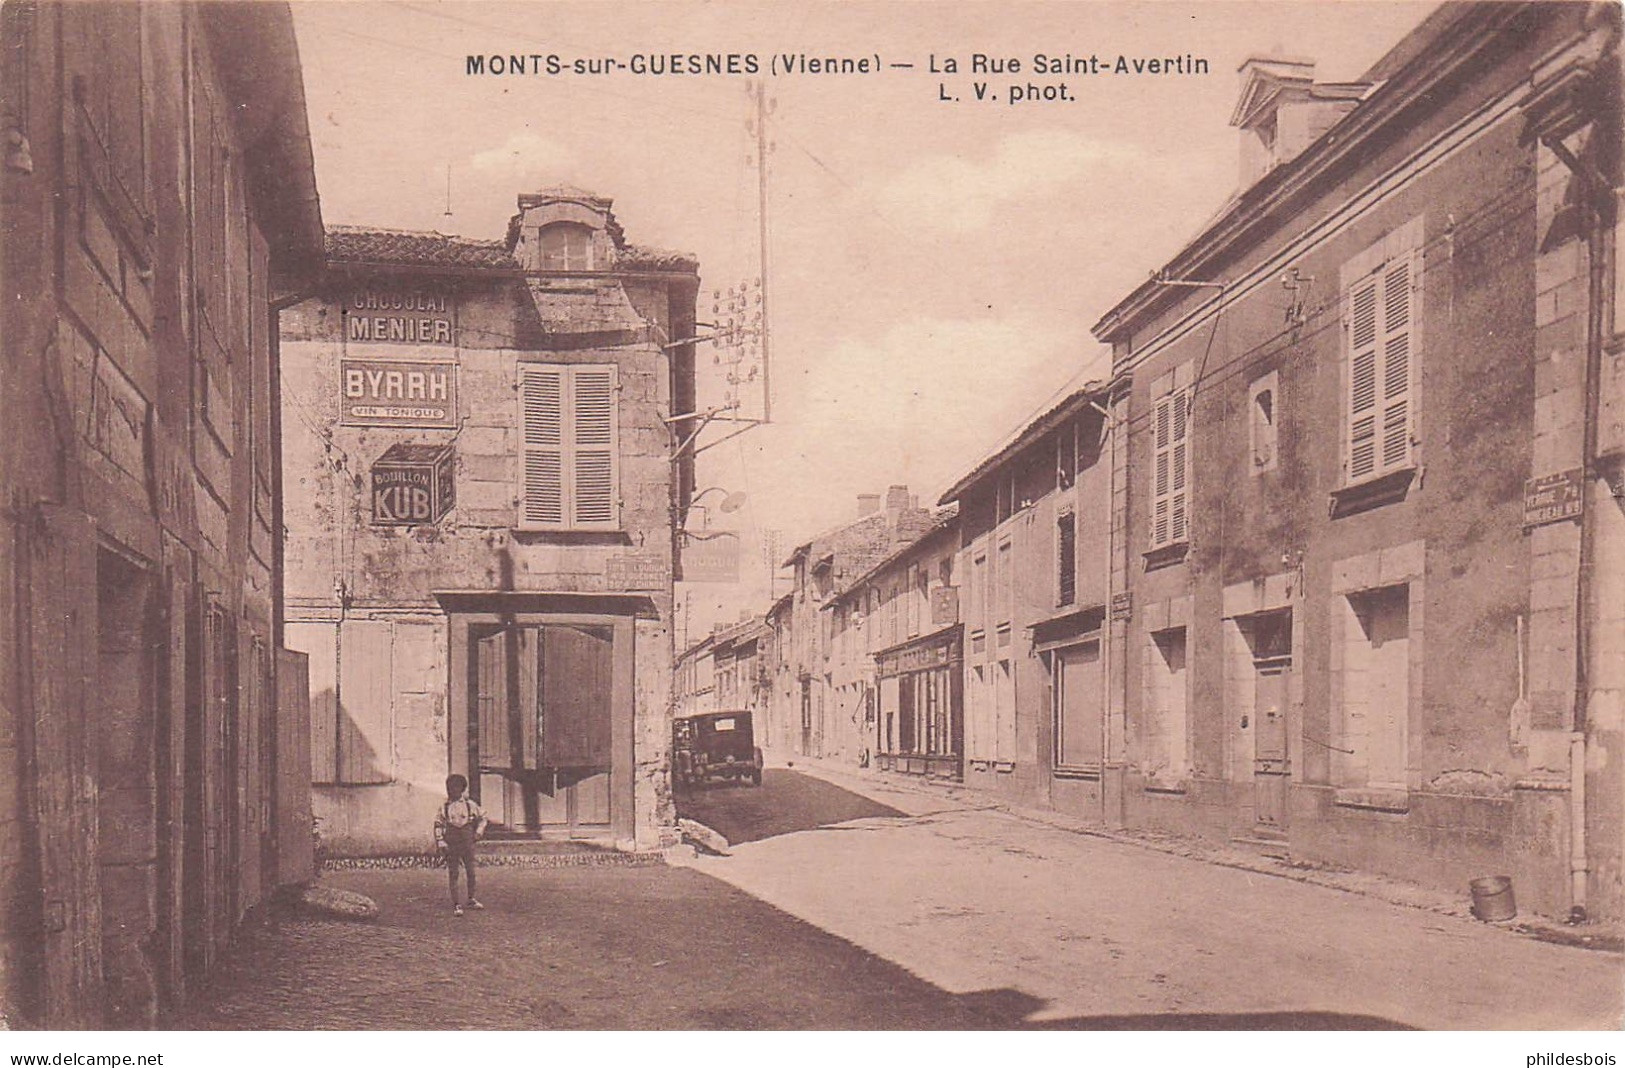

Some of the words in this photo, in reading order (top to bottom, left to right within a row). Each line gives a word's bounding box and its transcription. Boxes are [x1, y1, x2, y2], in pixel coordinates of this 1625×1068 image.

[354, 292, 447, 312] CHOCOLAT
[351, 317, 451, 342] MENIER
[346, 369, 447, 400] BYRRH
[355, 406, 377, 415] VIN
[385, 408, 441, 418] TONIQUE
[374, 471, 429, 485] BOUILLON
[375, 486, 431, 520] KUB
